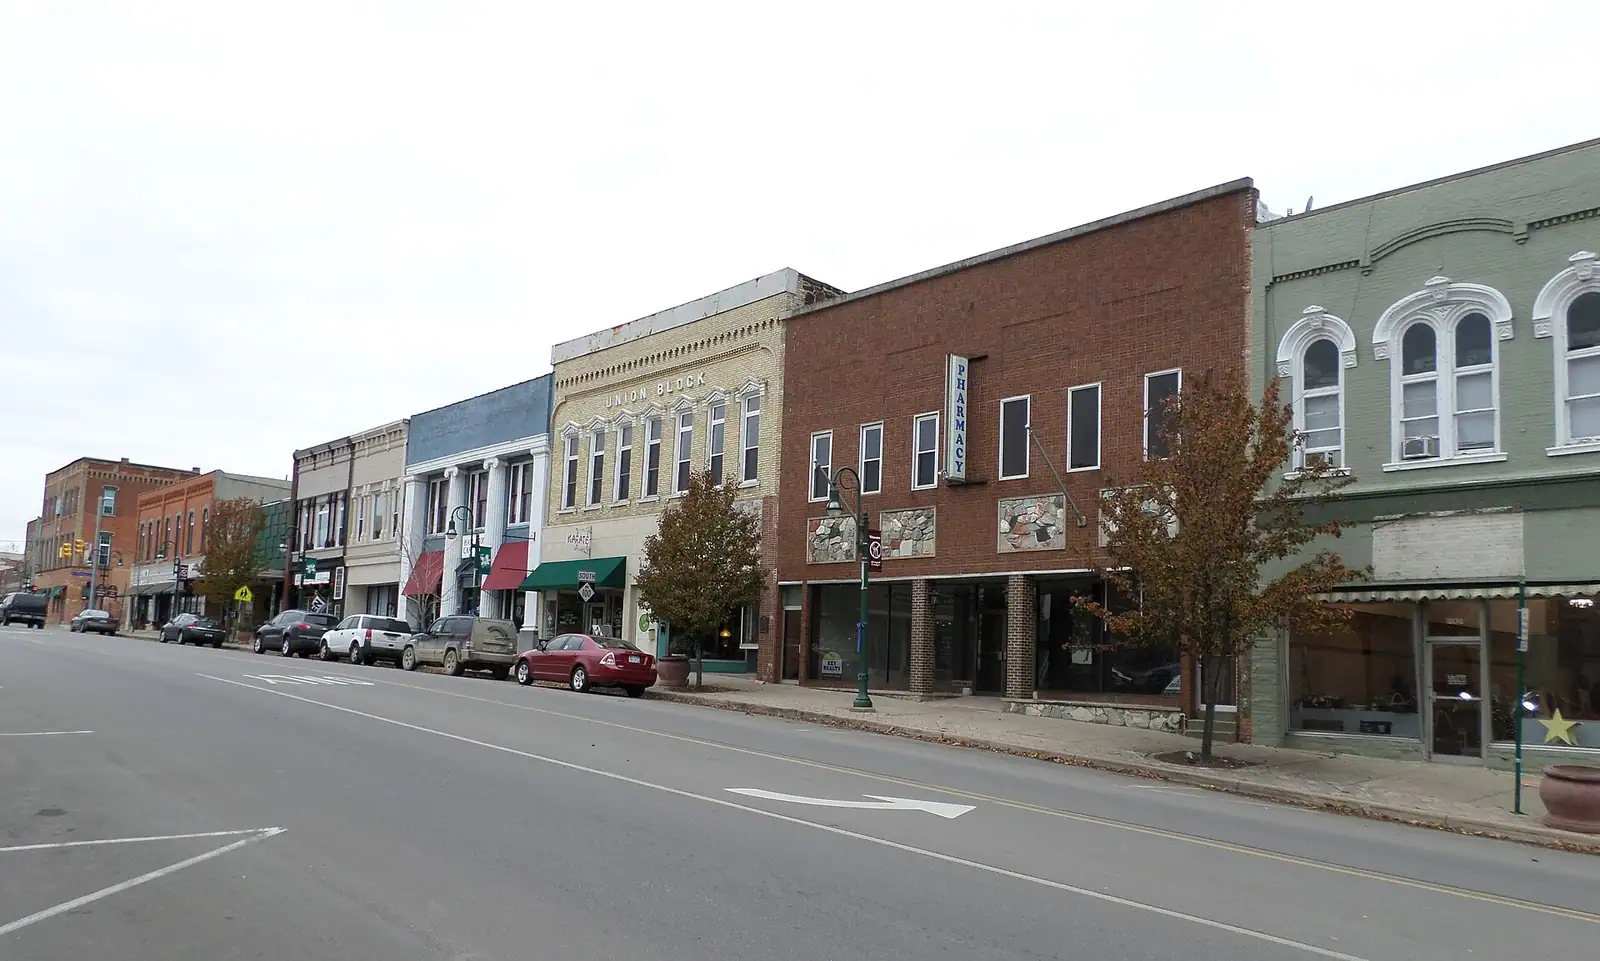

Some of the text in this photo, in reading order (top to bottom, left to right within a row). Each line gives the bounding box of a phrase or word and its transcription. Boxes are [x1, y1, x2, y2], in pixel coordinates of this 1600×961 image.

[605, 371, 706, 408] UNION BLOCK
[955, 363, 966, 473] PHARMACY
[567, 533, 589, 545] KARATE
[579, 572, 596, 580] SOUTH
